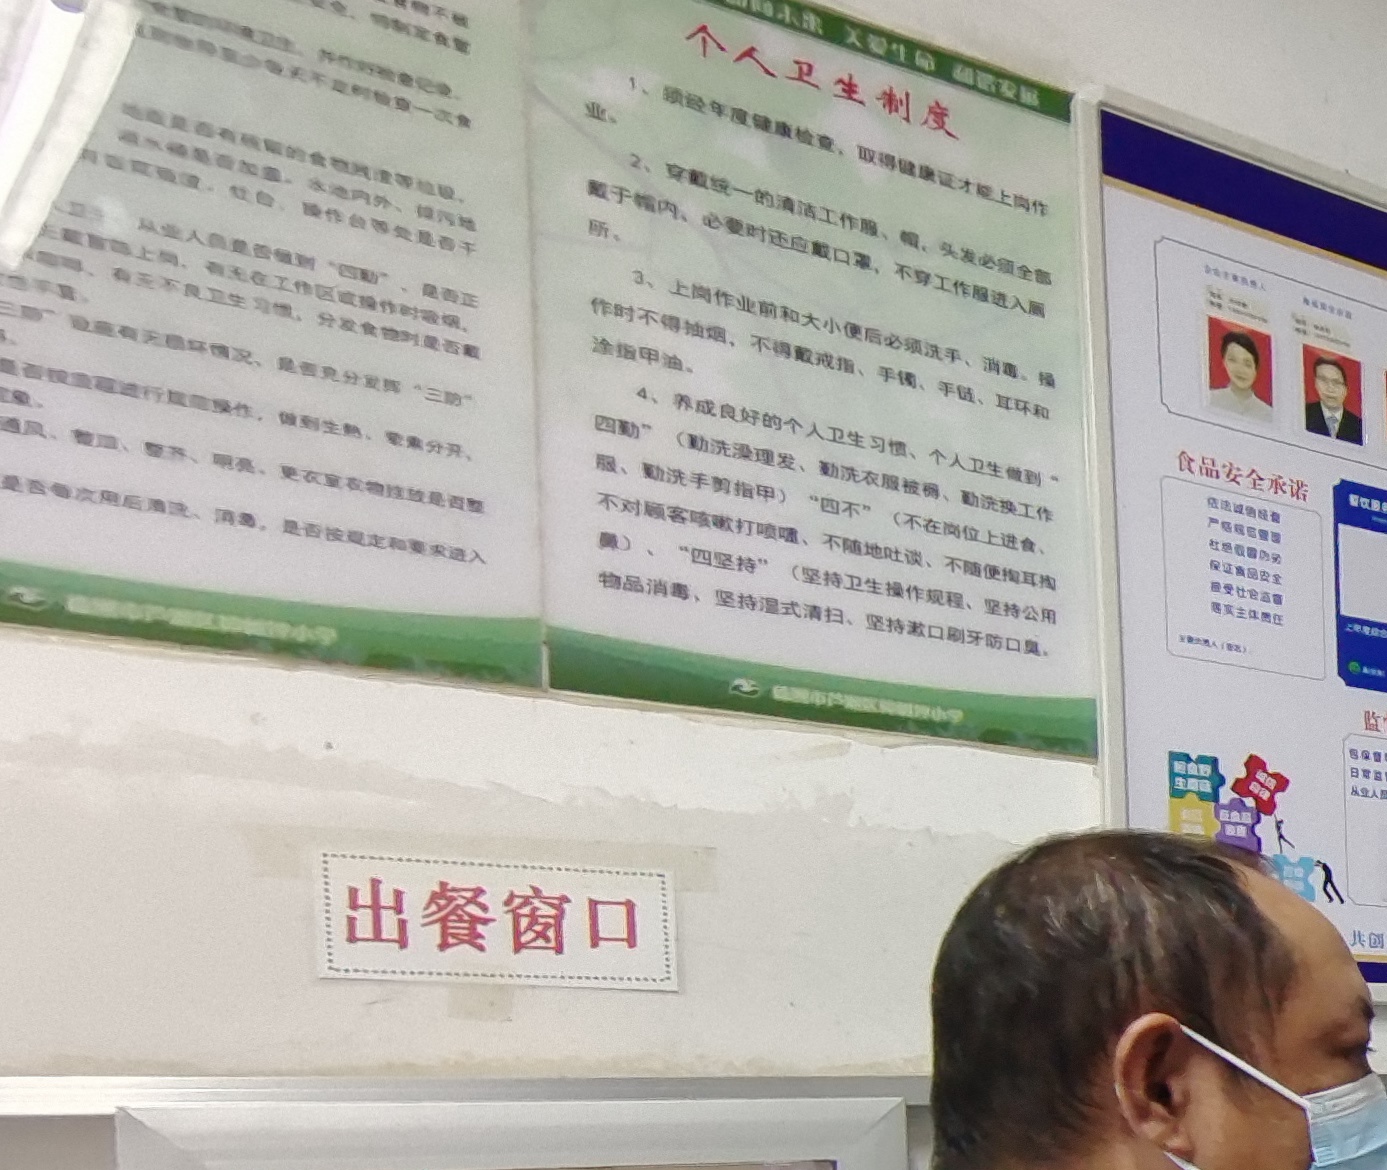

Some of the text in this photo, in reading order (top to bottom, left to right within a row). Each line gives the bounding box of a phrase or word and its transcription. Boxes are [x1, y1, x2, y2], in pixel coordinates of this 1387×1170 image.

[686, 24, 959, 140] 个人卫生制度
[1178, 450, 1309, 502] 食品安全承诺
[346, 877, 638, 954] 出餐窗口
